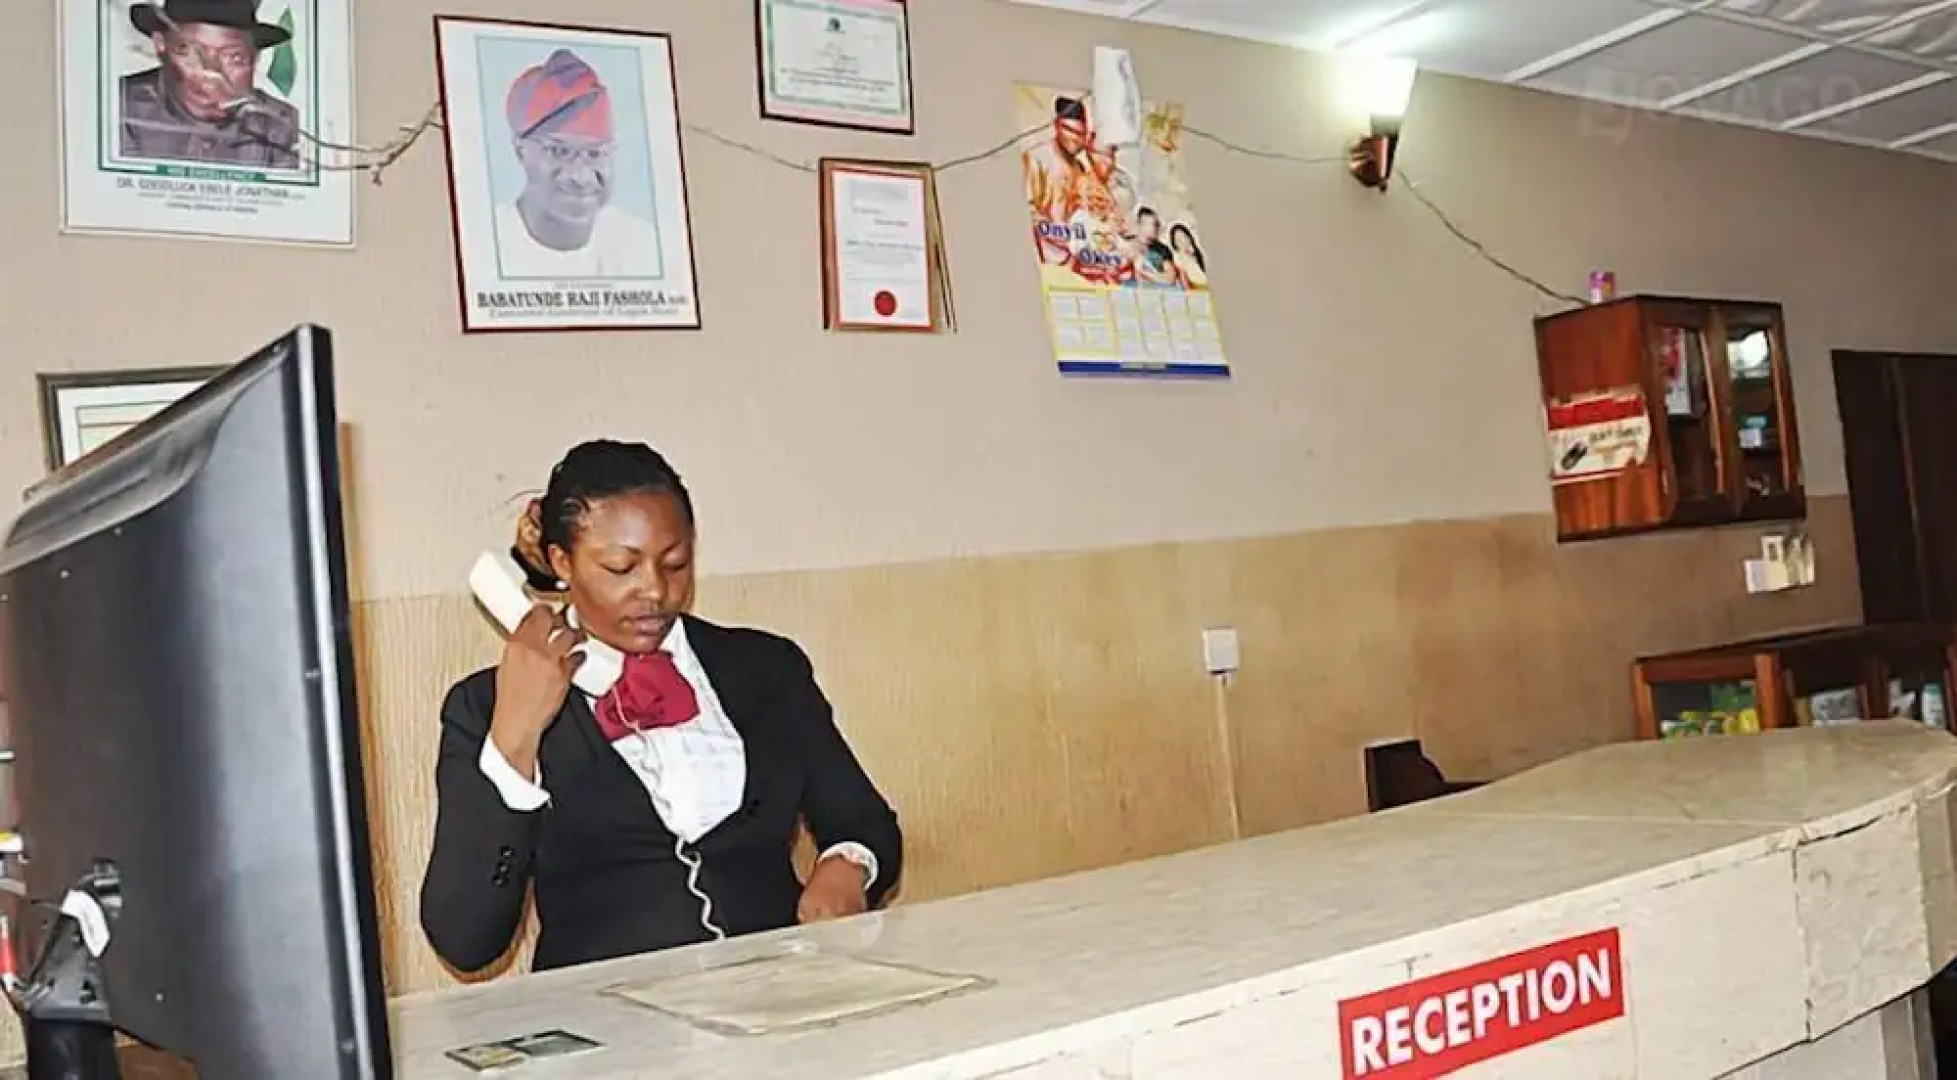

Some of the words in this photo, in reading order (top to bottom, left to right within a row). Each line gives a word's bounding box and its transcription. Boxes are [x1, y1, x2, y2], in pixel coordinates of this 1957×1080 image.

[477, 291, 563, 308] BABATUNDE
[568, 291, 600, 308] RAJI
[603, 290, 666, 307] FASHOLA
[1351, 948, 1612, 1076] RECEPTION
